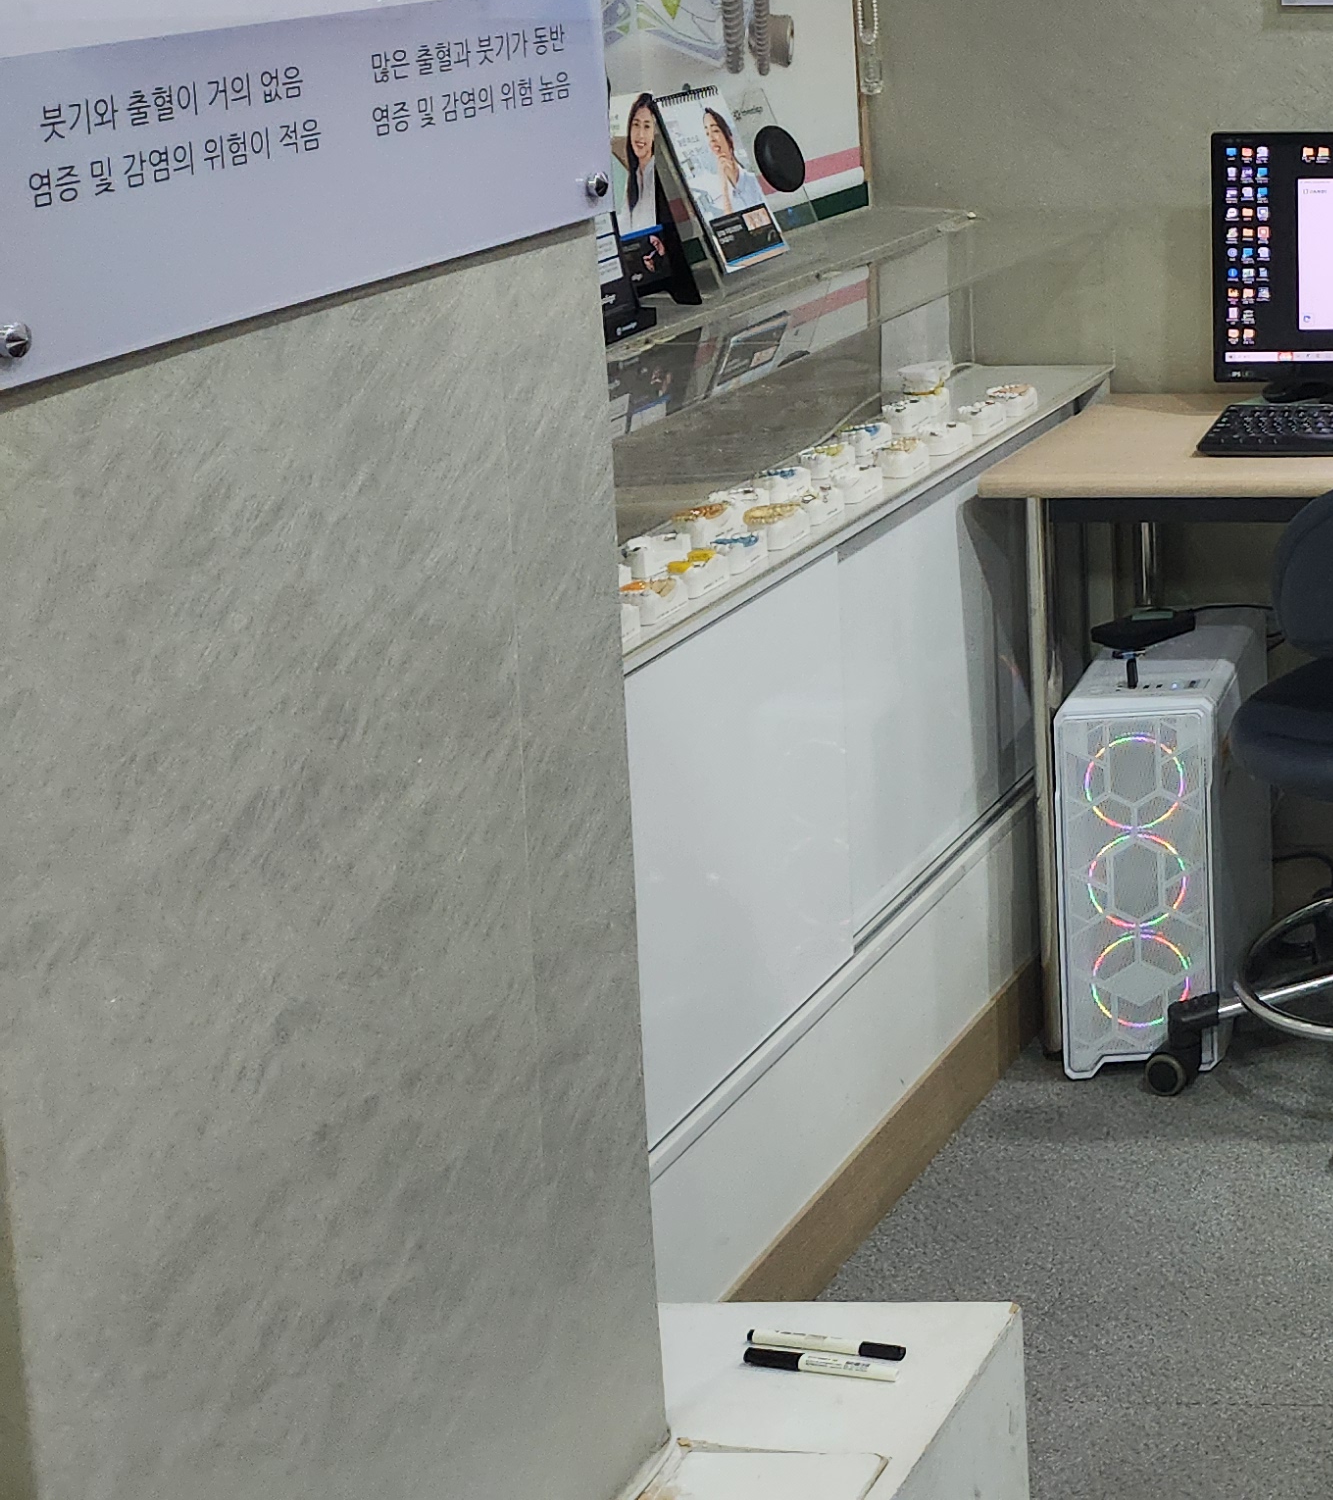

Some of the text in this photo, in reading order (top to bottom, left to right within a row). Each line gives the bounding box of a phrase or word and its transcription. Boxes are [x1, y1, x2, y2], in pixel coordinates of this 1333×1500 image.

[371, 23, 565, 83] 많은 출혈과 붓기가 동반
[39, 65, 304, 143] 붓기와 출혈이 거의 없음
[372, 71, 571, 137] 염증 및 감염의 위험 높음
[28, 118, 322, 208] 염증 및 감염의 위험이 적음
